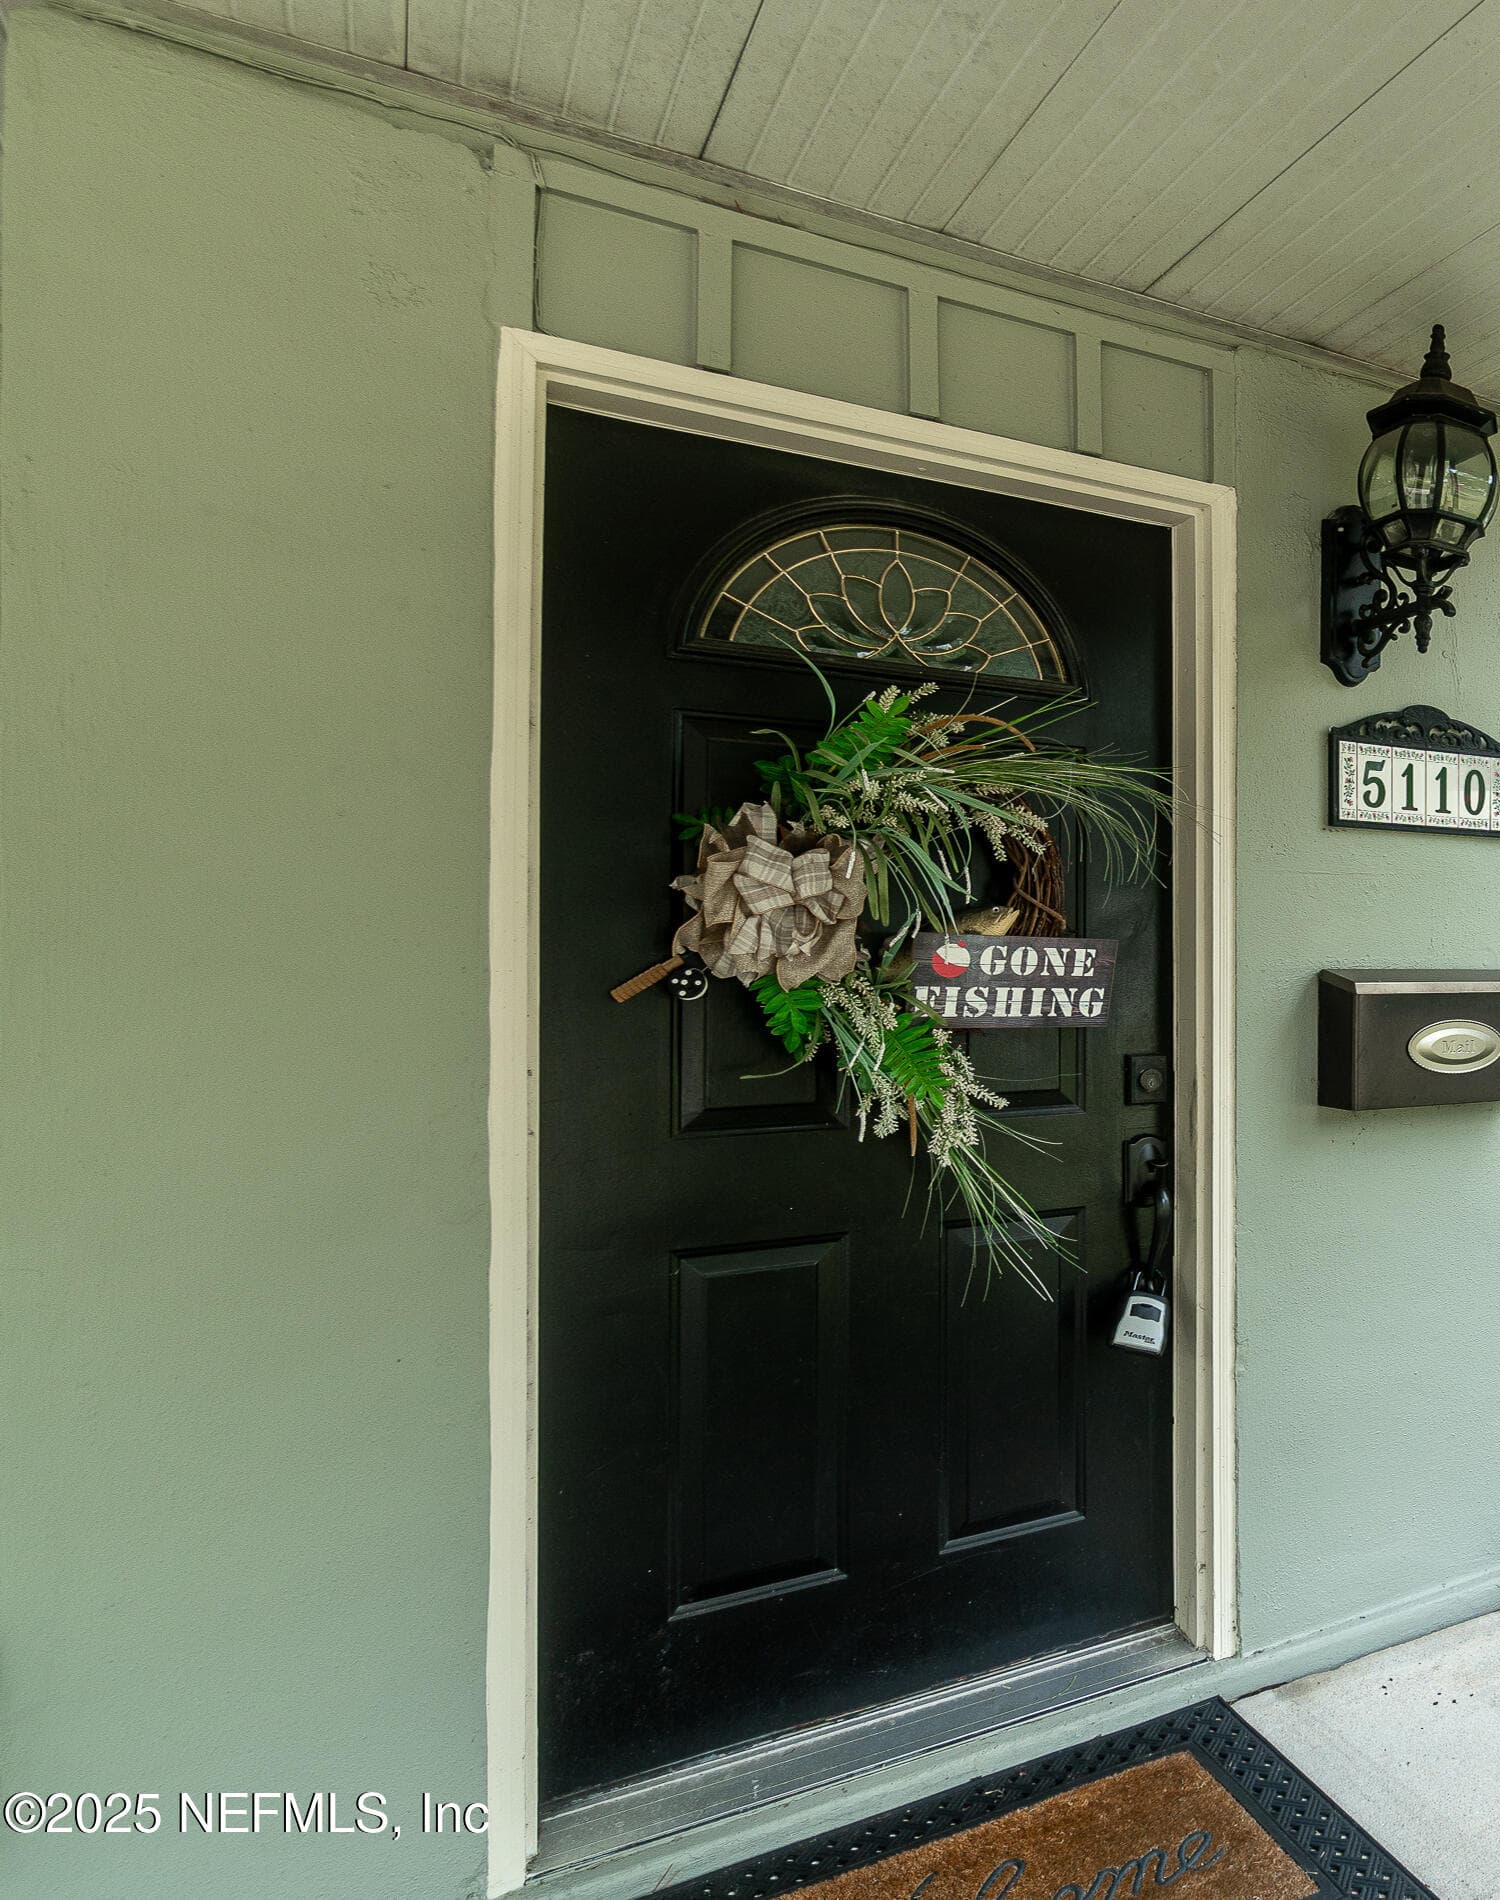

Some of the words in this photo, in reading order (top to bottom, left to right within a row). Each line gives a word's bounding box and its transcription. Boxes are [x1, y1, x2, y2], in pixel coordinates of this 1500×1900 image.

[1362, 759, 1486, 816] 5110
[979, 945, 1097, 977] GONE
[914, 985, 1105, 1018] FISHING
[1122, 1330, 1156, 1343] Master
